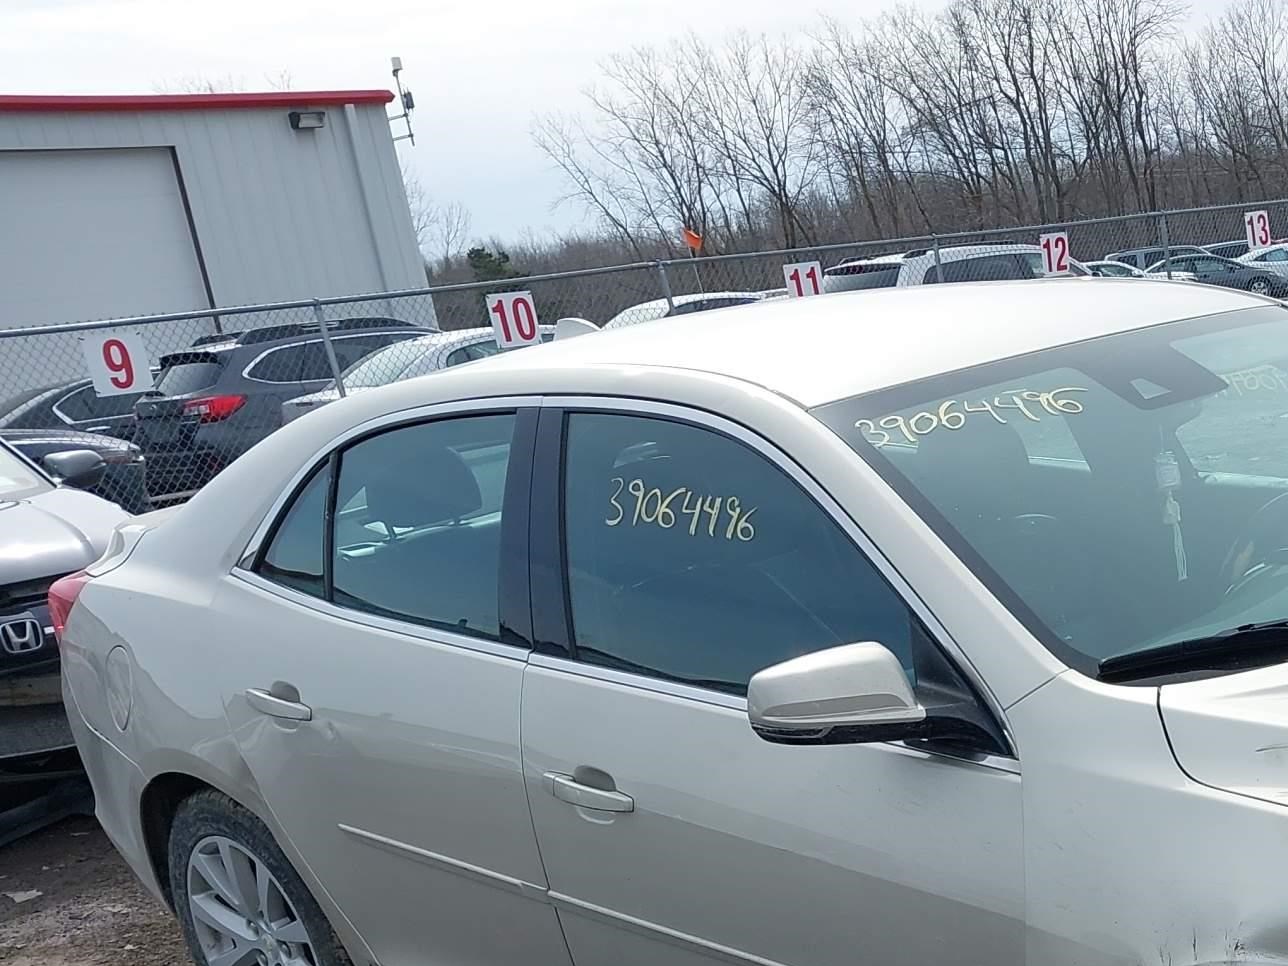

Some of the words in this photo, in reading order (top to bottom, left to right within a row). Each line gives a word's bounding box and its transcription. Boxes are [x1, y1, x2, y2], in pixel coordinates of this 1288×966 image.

[1247, 213, 1269, 247] 13
[1042, 236, 1068, 273] 12
[789, 266, 820, 297] 11
[491, 297, 536, 342] 10
[102, 338, 135, 389] 9
[854, 387, 1089, 448] 39064496
[605, 477, 758, 541] 39064496
